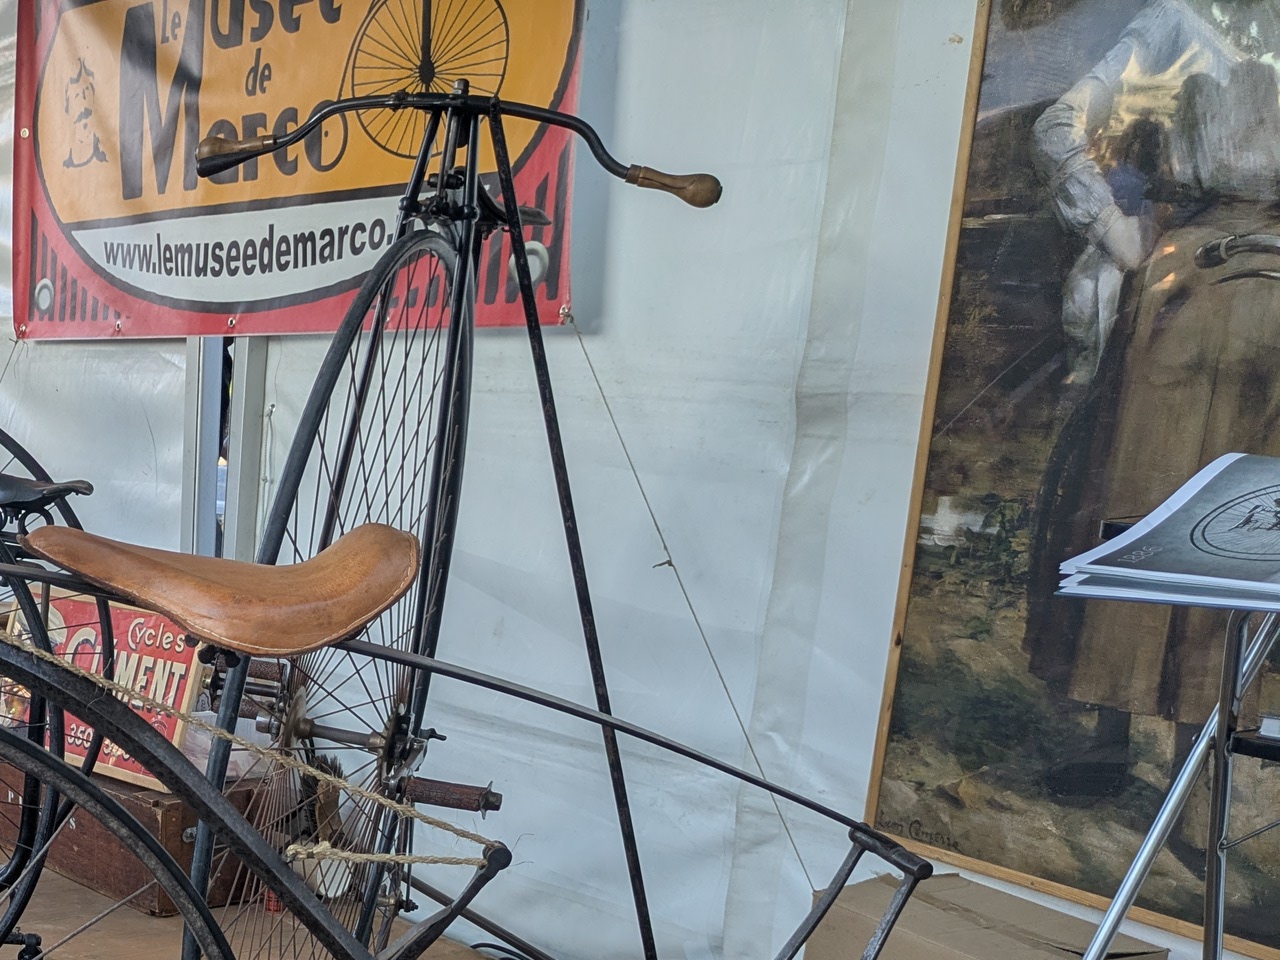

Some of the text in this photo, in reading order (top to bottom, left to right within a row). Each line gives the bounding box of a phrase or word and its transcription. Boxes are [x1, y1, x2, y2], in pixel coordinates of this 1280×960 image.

[245, 47, 272, 97] de
[104, 217, 398, 278] www.lemuseedemarco.
[128, 617, 186, 653] Cycles
